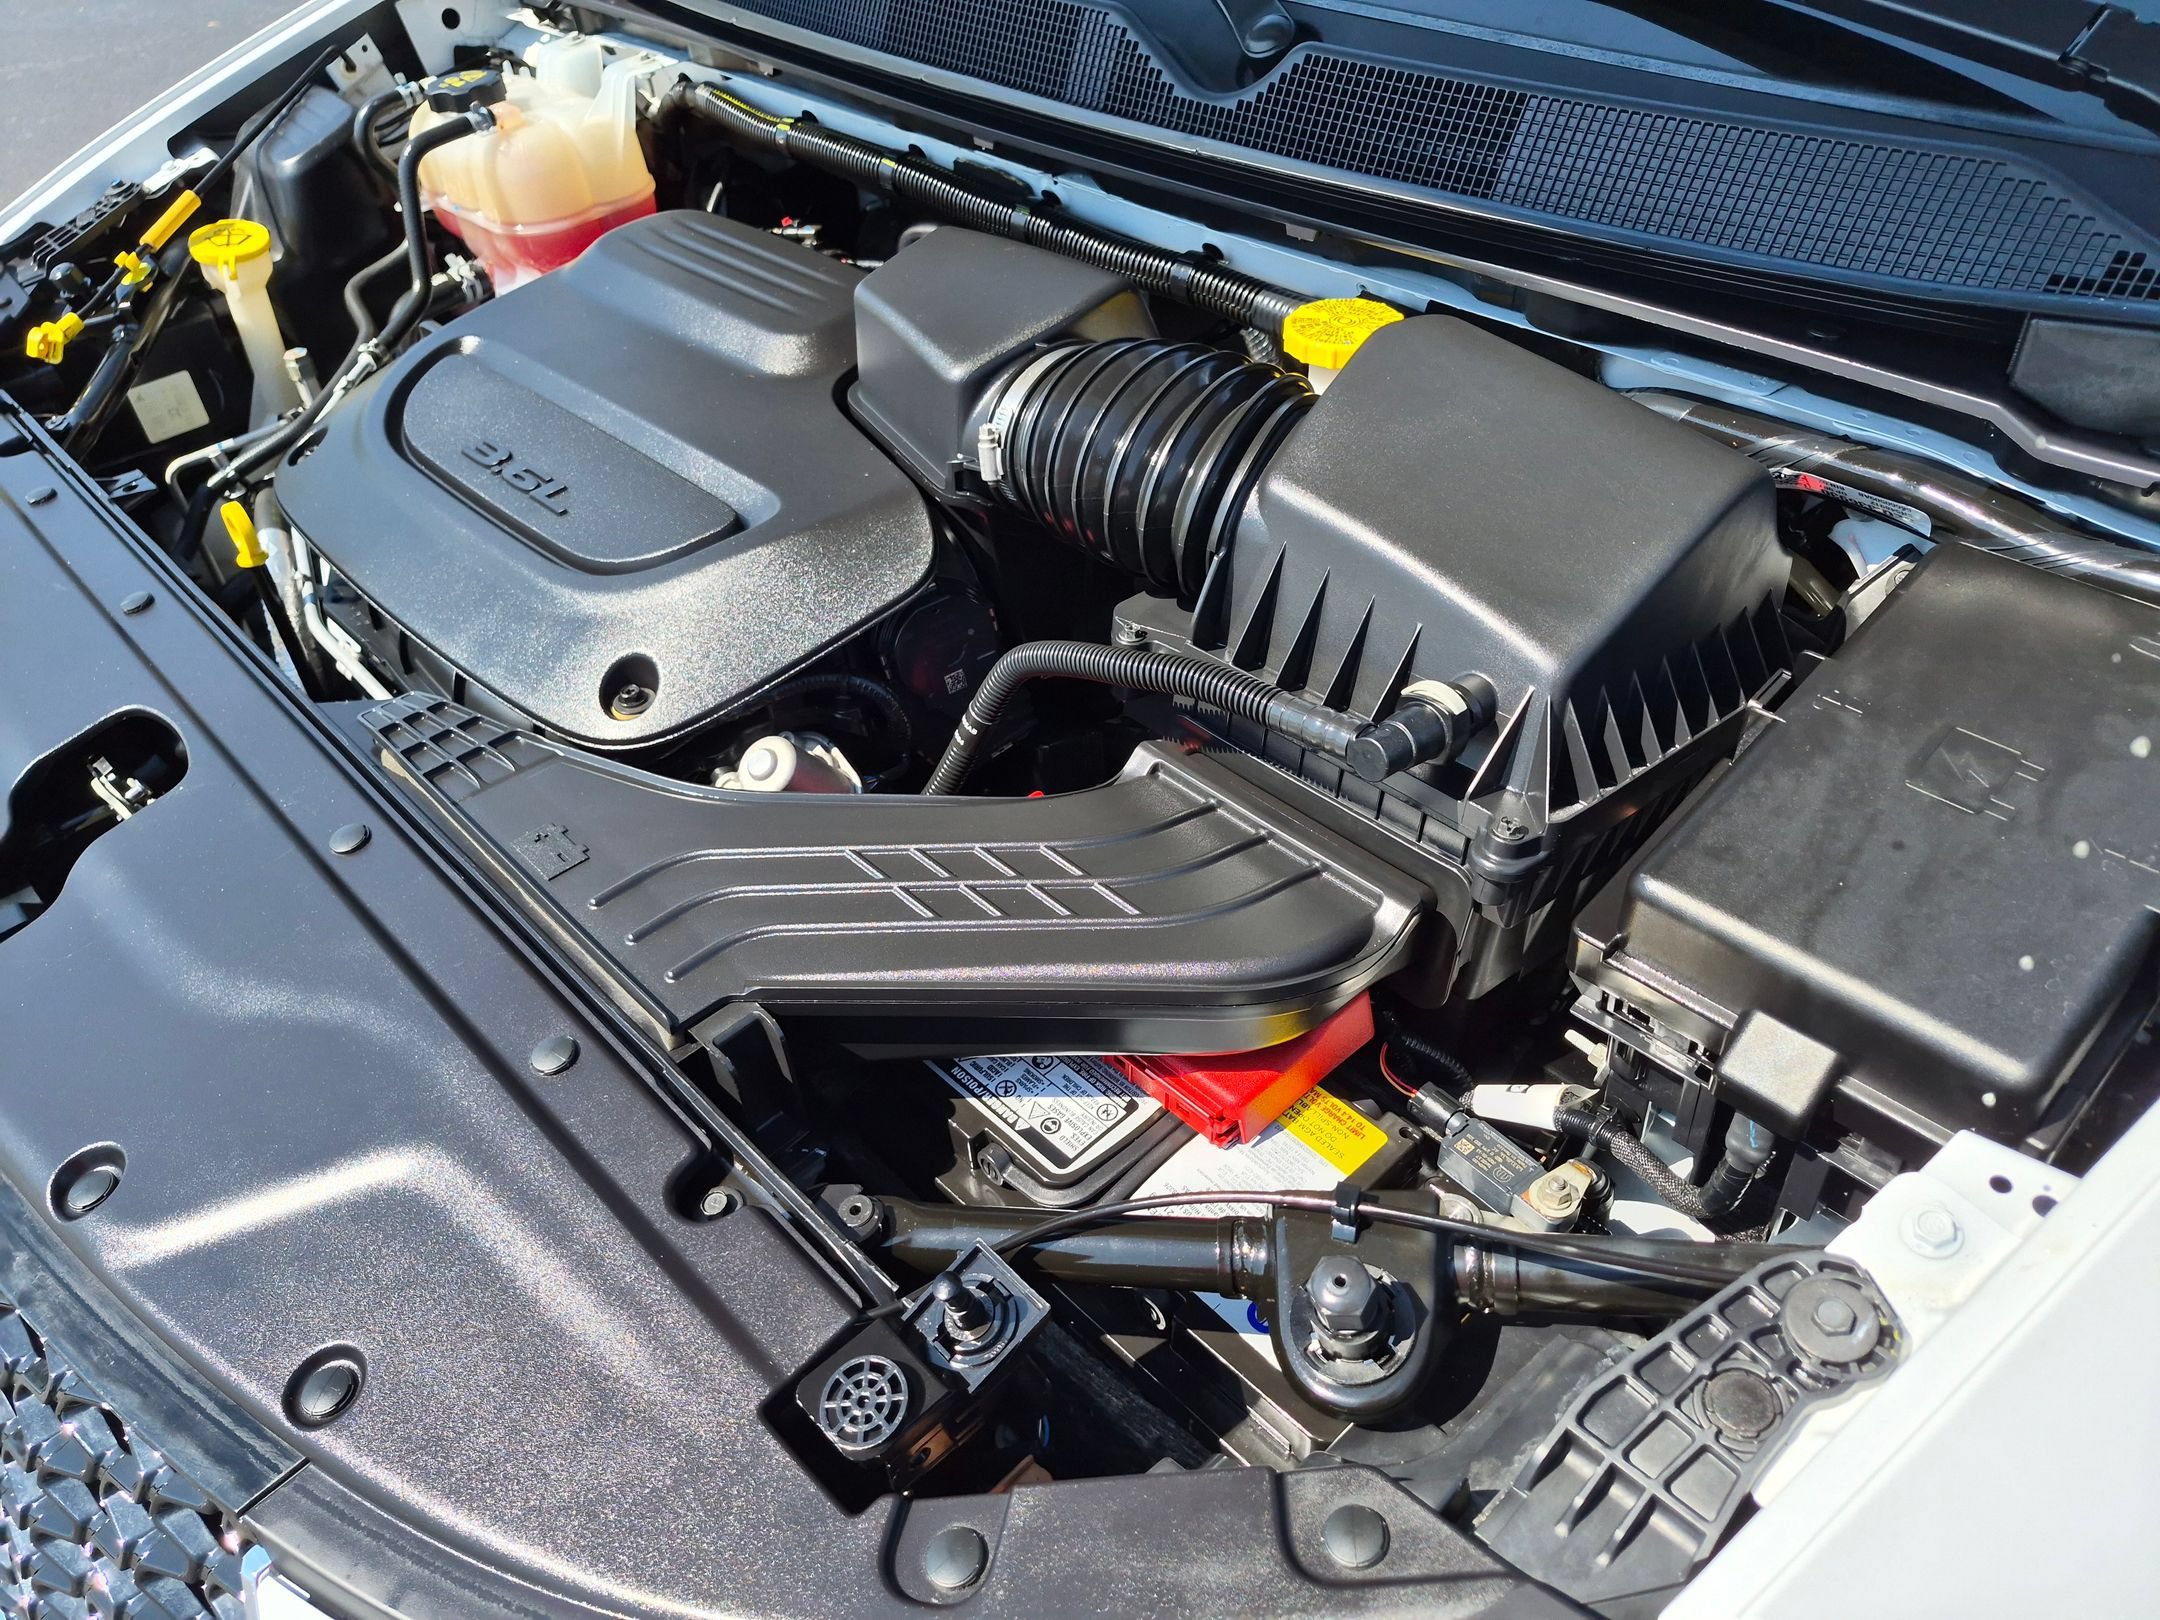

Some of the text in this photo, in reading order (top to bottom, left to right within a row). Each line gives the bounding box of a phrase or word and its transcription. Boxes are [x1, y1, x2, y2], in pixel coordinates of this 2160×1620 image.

[461, 441, 569, 516] 3.6L
[968, 1060, 994, 1080] SULFURIC
[985, 1064, 1000, 1075] ACID
[1307, 1086, 1321, 1098] MA
[1319, 1095, 1343, 1113] VOLTS
[1046, 1103, 1092, 1140] EXPLOSIVE GASES
[1295, 1097, 1349, 1139] NON-SPILLABL
[1301, 1090, 1366, 1140] LIMIT CHARGE VOLT
[1281, 1109, 1345, 1159] SEALED AGM BAT
[1309, 1120, 1325, 1133] NOT
[1354, 1120, 1366, 1131] TO
[1058, 1134, 1079, 1151] SHIELD
[1323, 1131, 1337, 1142] DO
